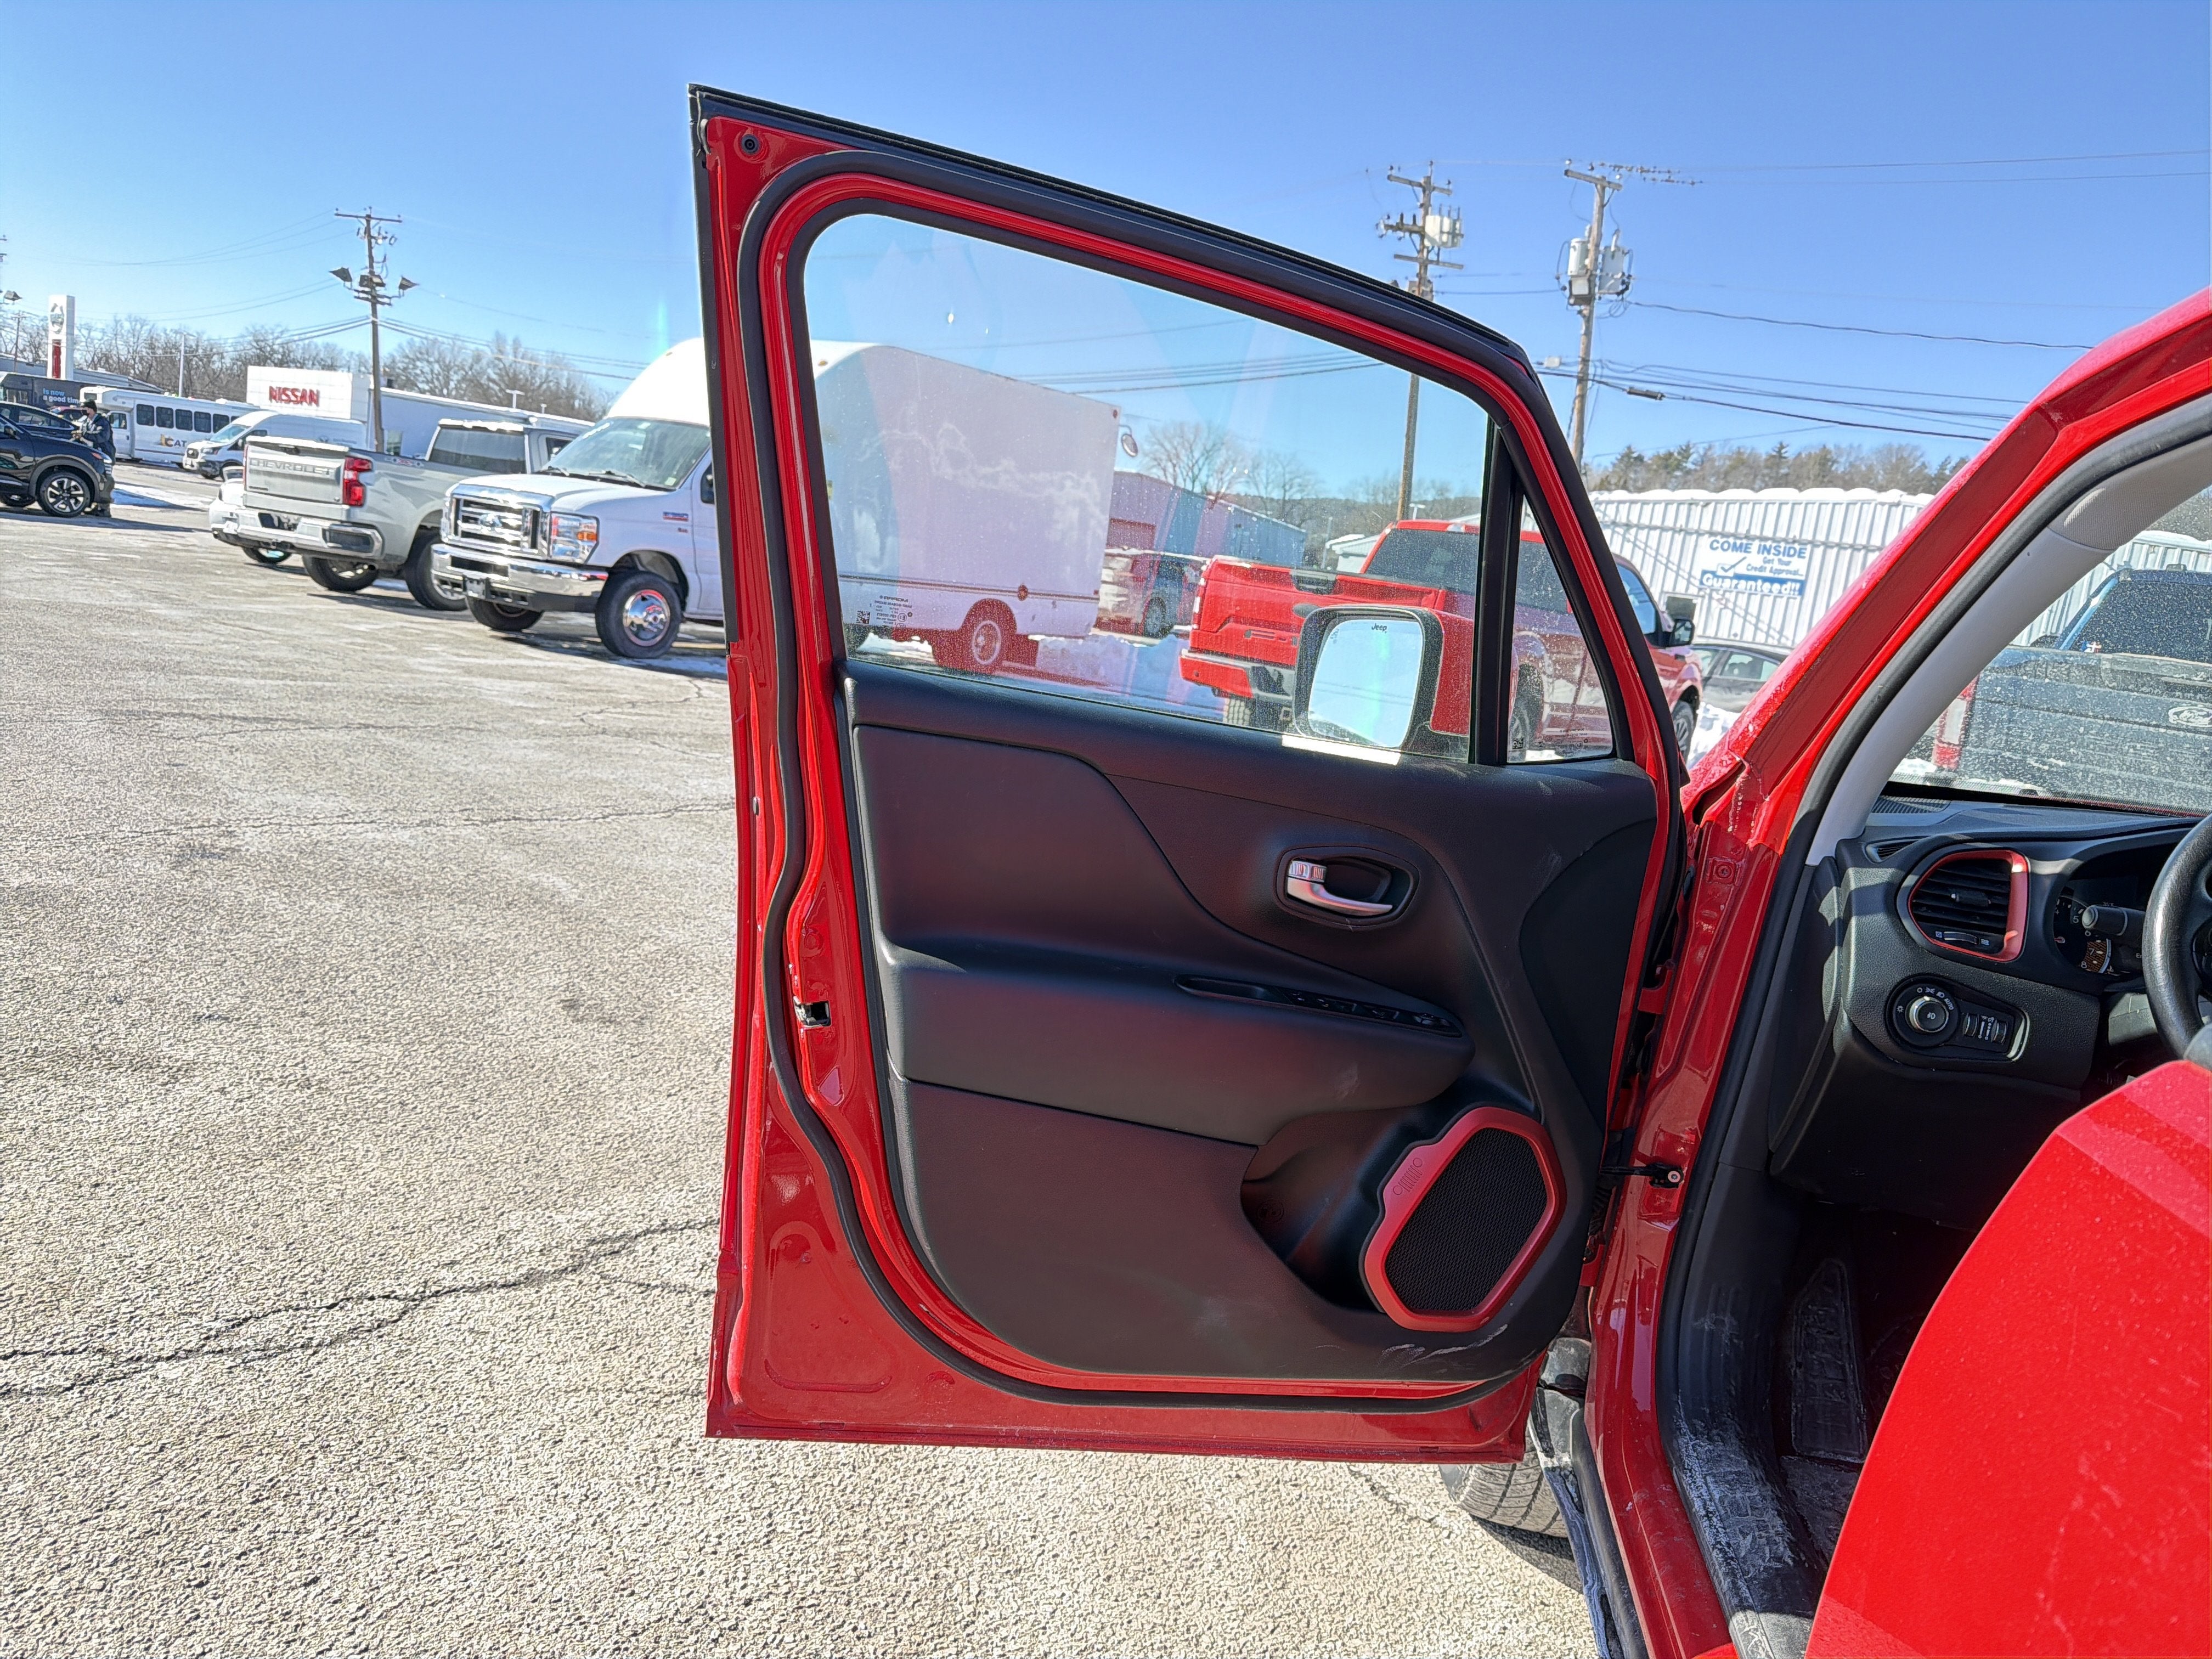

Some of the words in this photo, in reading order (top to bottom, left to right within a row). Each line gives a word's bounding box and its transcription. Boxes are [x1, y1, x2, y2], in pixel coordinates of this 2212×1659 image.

[269, 386, 320, 407] NISSAN
[1709, 539, 1753, 554] COME
[1757, 544, 1807, 558] INSIDE
[1746, 563, 1767, 572] Credit
[1702, 573, 1801, 595] Guaranteed!!
[1372, 623, 1387, 631] Jeep
[2089, 947, 2095, 956] 7
[1944, 998, 1954, 1010] AUTO
